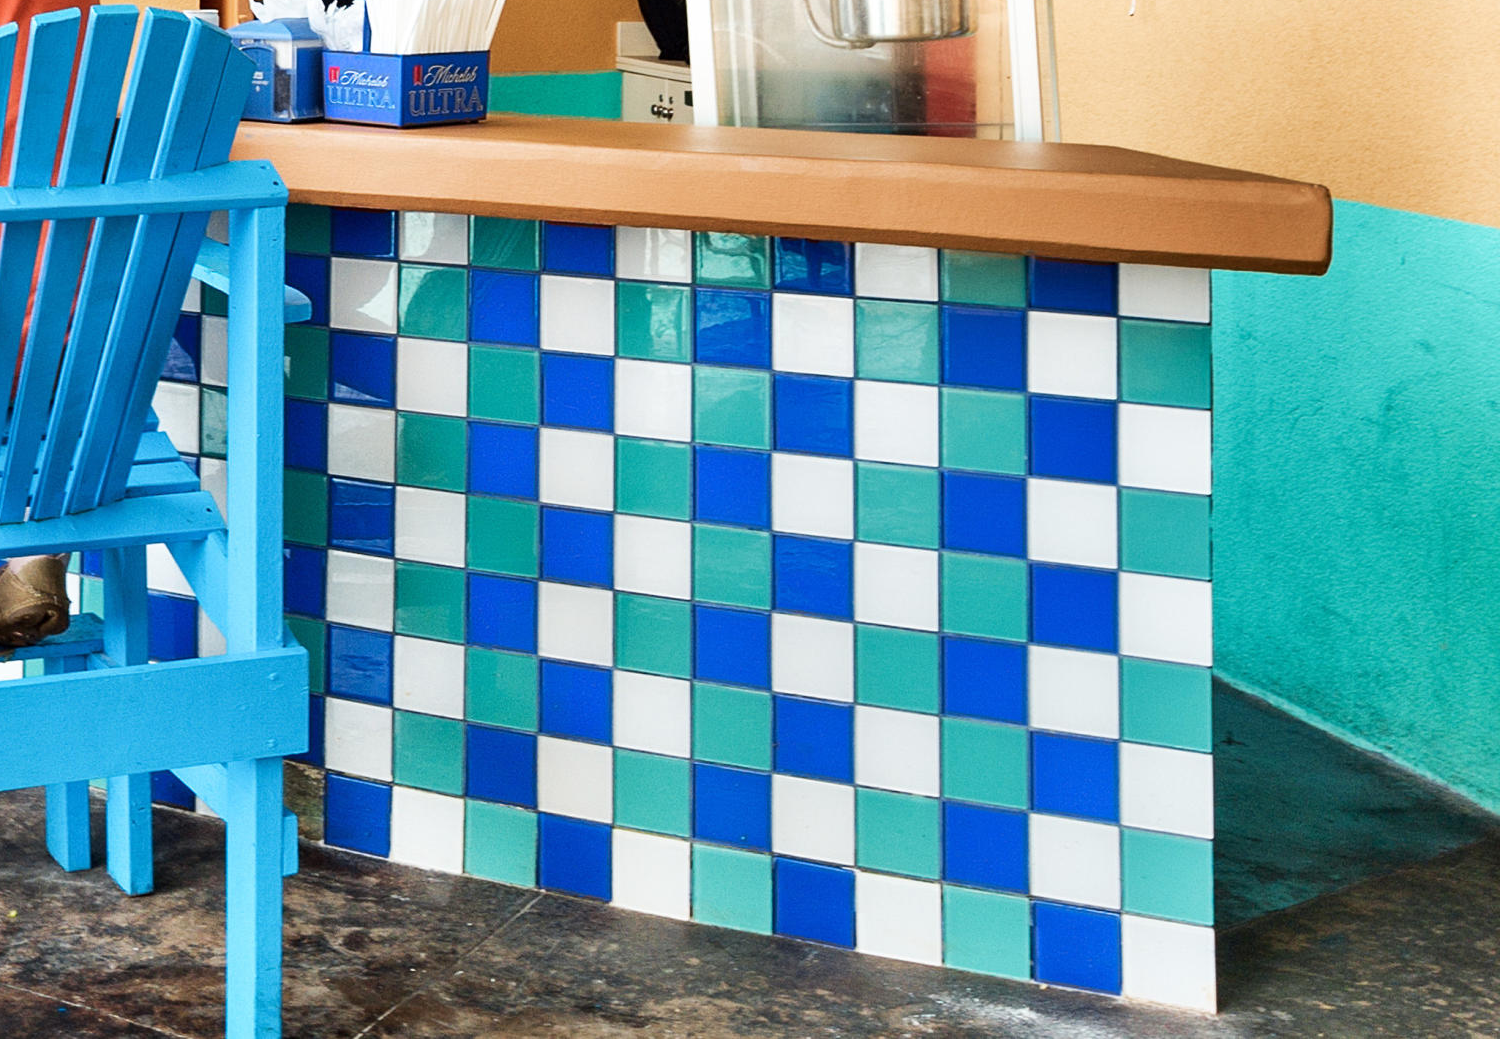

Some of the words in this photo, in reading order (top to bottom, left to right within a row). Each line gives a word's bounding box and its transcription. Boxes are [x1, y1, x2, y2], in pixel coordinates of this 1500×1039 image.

[340, 70, 388, 87] Michelob
[424, 64, 478, 86] Michelob
[327, 85, 392, 109] ULTRA
[408, 86, 483, 116] ULTRA
